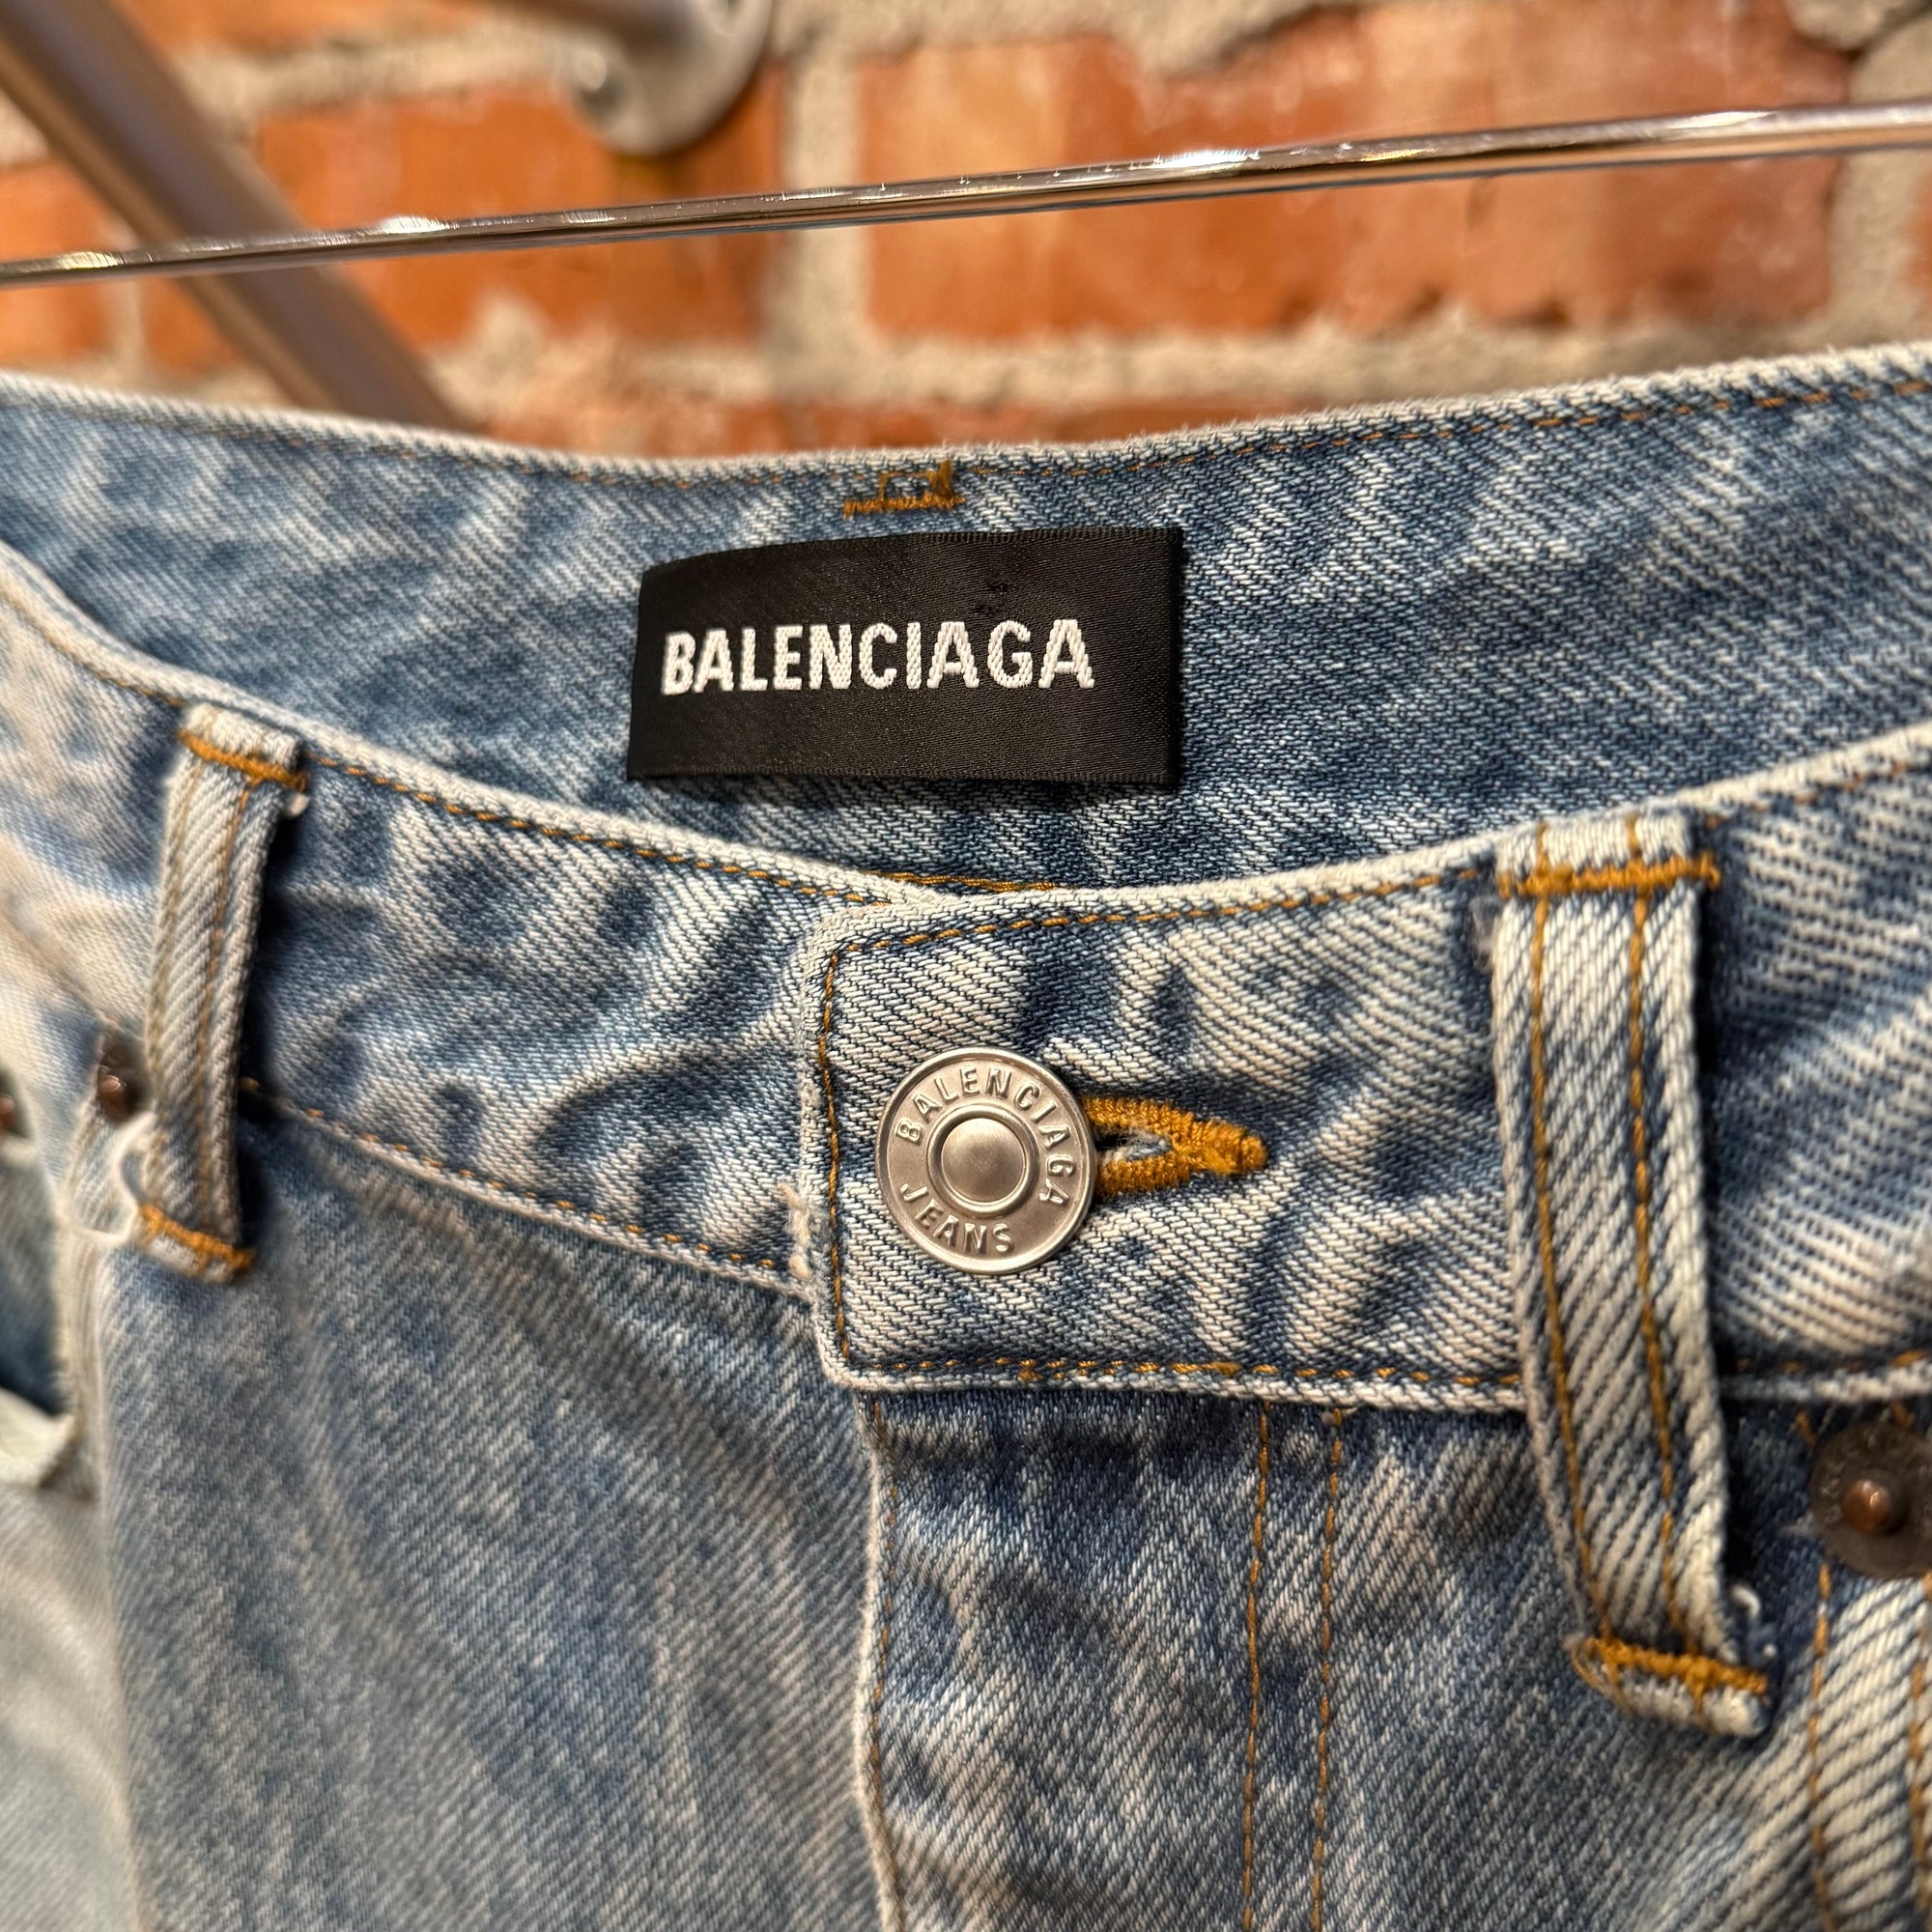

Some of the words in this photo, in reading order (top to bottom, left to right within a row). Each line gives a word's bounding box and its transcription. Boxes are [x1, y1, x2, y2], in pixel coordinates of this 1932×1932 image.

[661, 619, 1094, 696] BALENCIAGA
[895, 1065, 1075, 1206] BALENCIAGA
[899, 1182, 1014, 1253] JEANS
